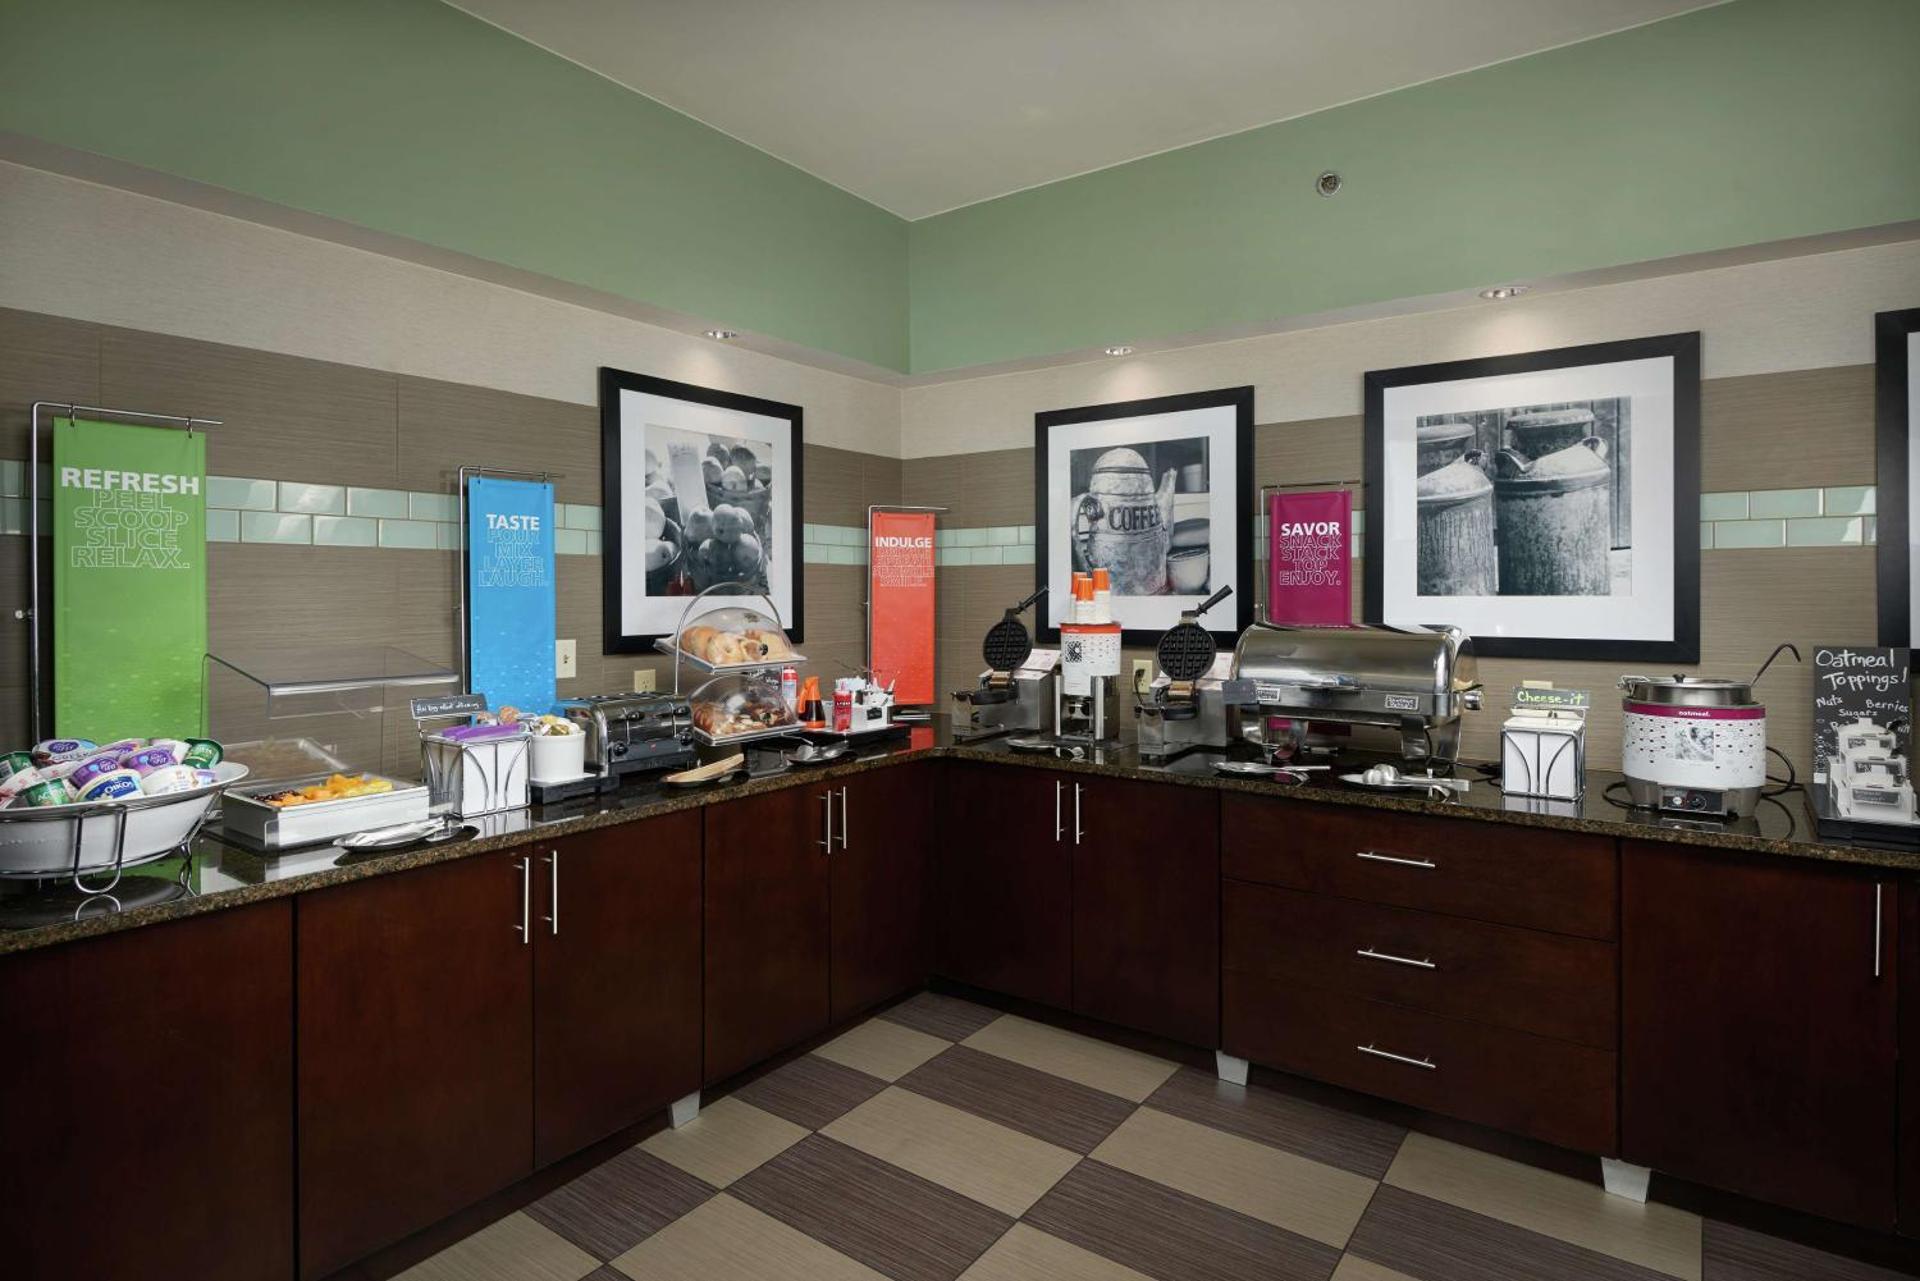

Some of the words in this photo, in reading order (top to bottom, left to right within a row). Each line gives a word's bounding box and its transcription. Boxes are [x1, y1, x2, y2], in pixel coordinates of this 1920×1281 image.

[61, 466, 199, 495] REFRESH
[93, 487, 171, 510] PEEL
[73, 506, 189, 531] SCOOP
[486, 513, 540, 531] TASTE
[1281, 522, 1340, 536] SAVOR
[86, 526, 177, 550] SLICE
[875, 536, 933, 548] INDULGE
[1280, 534, 1342, 548] SNACK
[71, 546, 190, 568] RELAX.
[495, 542, 533, 558] MIX
[1281, 545, 1340, 561] STACK
[1293, 558, 1328, 572] TOP
[1279, 570, 1342, 586] ENJOY.
[1815, 648, 1895, 669] Oatmeal
[1822, 666, 1908, 692] Toppings!
[1815, 694, 1844, 708] Nuts
